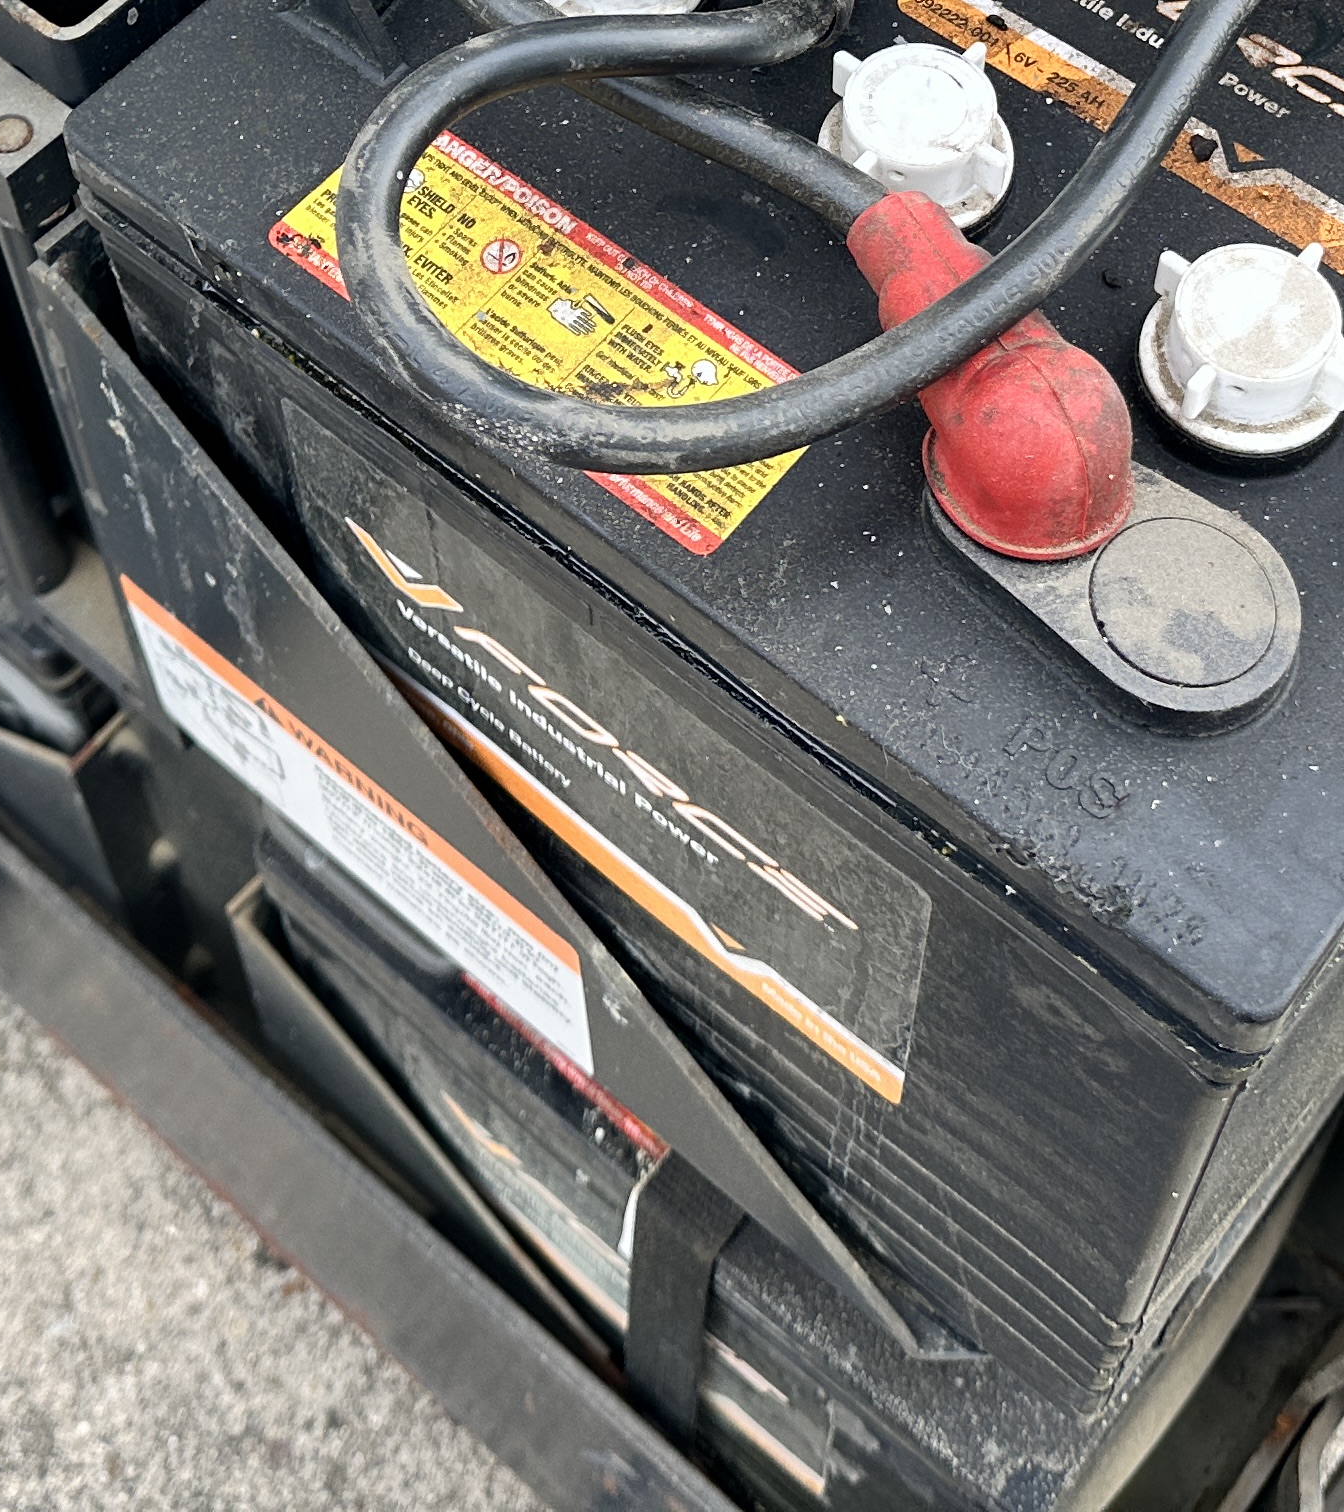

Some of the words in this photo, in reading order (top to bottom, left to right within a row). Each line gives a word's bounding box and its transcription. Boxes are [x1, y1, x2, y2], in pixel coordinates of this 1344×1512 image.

[1011, 50, 1038, 70] 6V
[1044, 70, 1079, 95] 225
[1075, 88, 1106, 111] AH
[1218, 70, 1292, 120] Power
[428, 131, 580, 235] ANGER/POISON
[404, 194, 440, 220] EYES.
[415, 184, 457, 215] SHIELD
[455, 212, 478, 230] NO
[444, 233, 473, 256] Flames
[450, 227, 480, 249] Sparks
[411, 253, 455, 286] EVITER
[436, 241, 471, 267] Smoking
[506, 283, 519, 293] or
[513, 275, 551, 302] blindness
[521, 268, 538, 282] can
[534, 277, 558, 296] cause
[479, 317, 504, 336] auser
[507, 324, 548, 357] Sulfurique
[619, 322, 648, 345] FLUSH
[643, 339, 665, 357] EYES
[685, 333, 699, 346] ET
[694, 339, 707, 351] AU
[605, 338, 628, 356] WITH
[678, 478, 708, 503] HANDS
[607, 468, 666, 516] erformance
[678, 520, 704, 545] Life
[395, 596, 503, 696] Versatile
[508, 686, 626, 799] Industrial
[633, 789, 720, 872] Power
[407, 644, 453, 693] Deep
[456, 682, 505, 735] Cycle
[508, 725, 572, 793] Battery
[453, 625, 860, 930] FORCE
[1001, 713, 1132, 821] POS
[286, 716, 430, 851] WARNING
